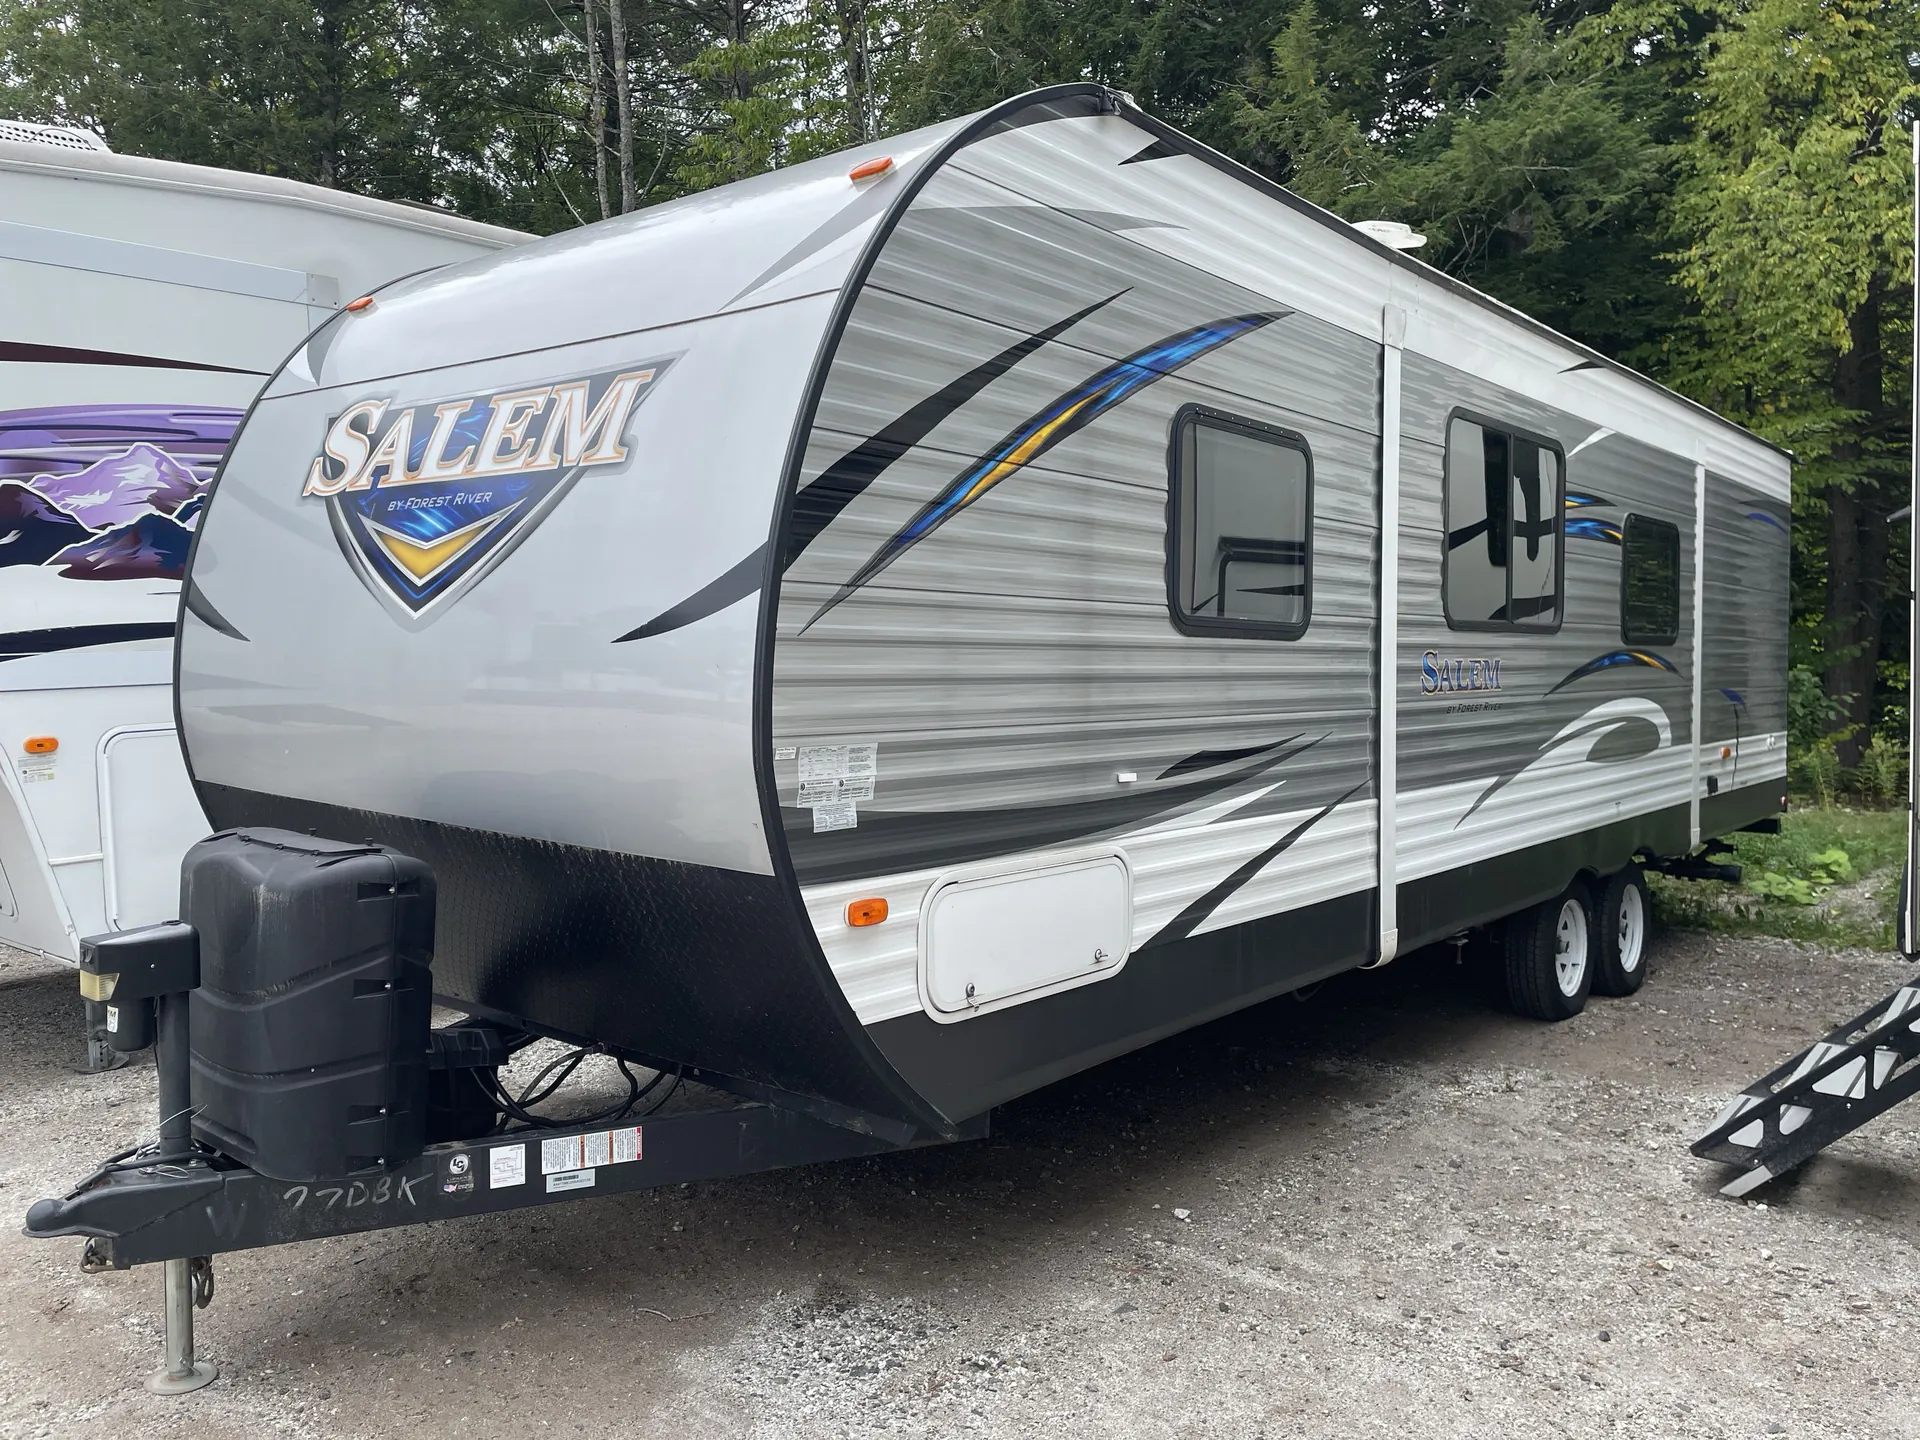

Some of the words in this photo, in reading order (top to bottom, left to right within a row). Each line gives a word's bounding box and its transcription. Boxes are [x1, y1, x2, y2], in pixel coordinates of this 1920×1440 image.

[302, 368, 656, 496] SALEM
[387, 500, 405, 511] BY
[405, 497, 452, 509] FOREST
[453, 491, 493, 506] RIVER
[1420, 649, 1502, 695] SALEM
[1446, 706, 1457, 714] BY
[1457, 703, 1482, 713] FOREST
[1484, 701, 1502, 711] RIVER
